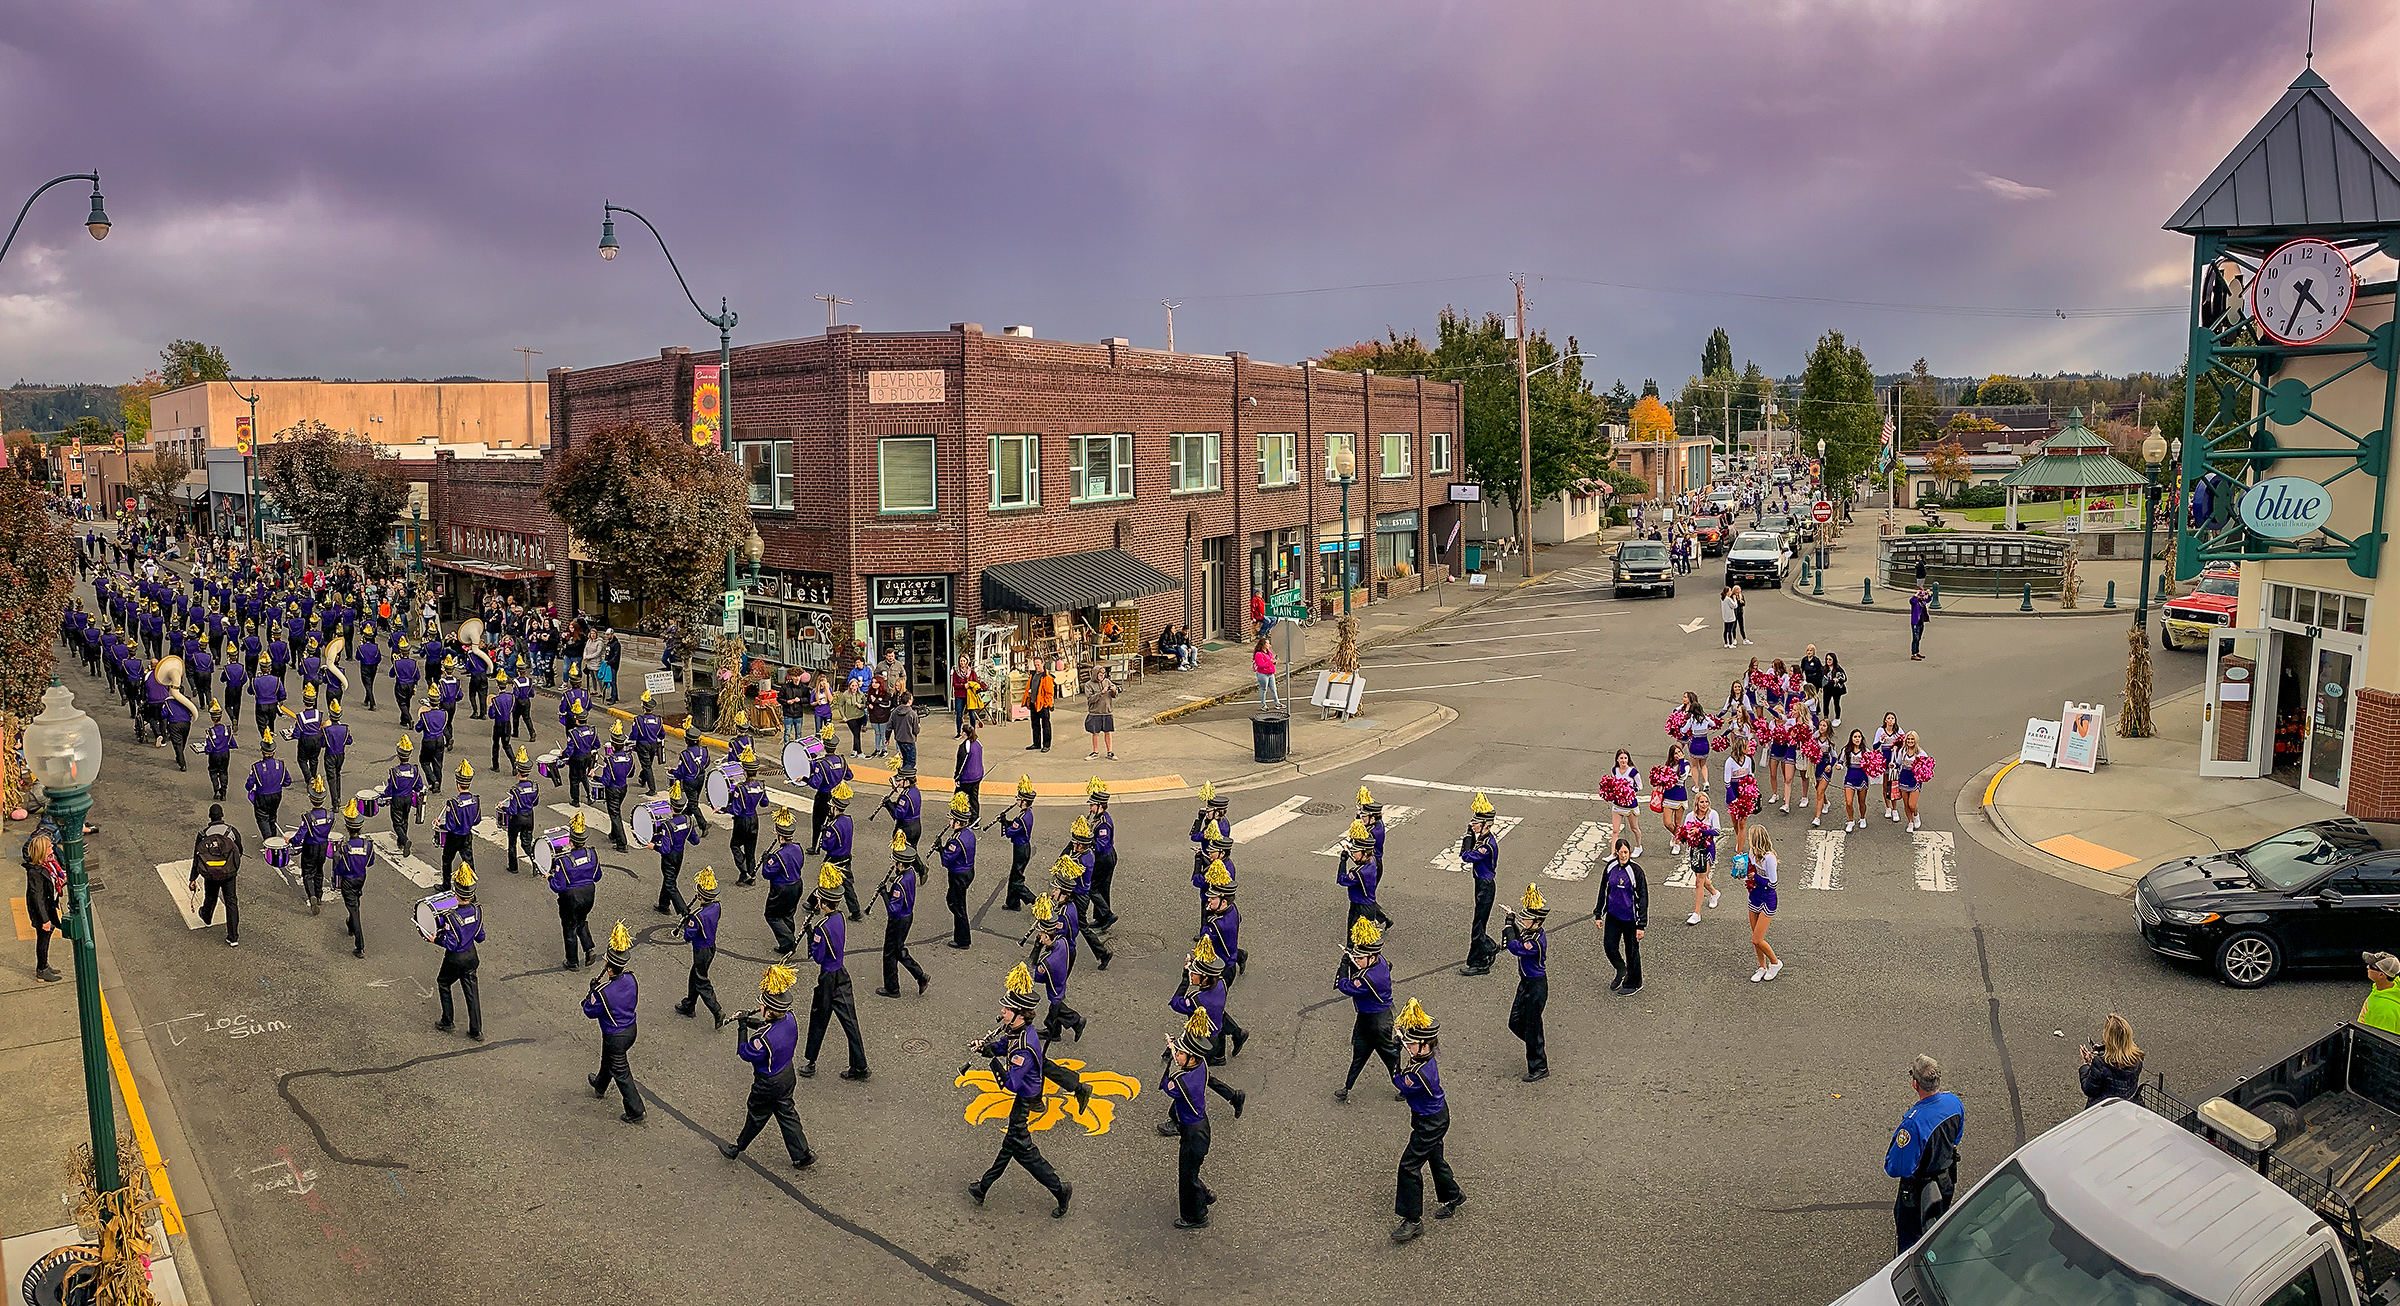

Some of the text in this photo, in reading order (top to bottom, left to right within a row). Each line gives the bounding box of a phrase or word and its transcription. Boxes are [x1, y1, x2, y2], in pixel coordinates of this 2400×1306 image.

[2283, 253, 2293, 265] 11
[2301, 247, 2313, 259] 12
[2323, 252, 2328, 264] 1
[2267, 267, 2279, 280] 10
[2334, 266, 2342, 278] 2
[2263, 286, 2270, 299] 9
[2337, 285, 2345, 297] 3
[2266, 305, 2274, 318] 8
[2330, 304, 2338, 317] 4
[2279, 319, 2286, 331] 7
[2297, 324, 2304, 336] 6
[2315, 319, 2323, 331] 5
[871, 371, 943, 387] LEVERENZ
[873, 387, 942, 401] 19 BLDG 22
[2255, 484, 2321, 521] blue
[1392, 518, 1413, 527] ESTATE
[2260, 520, 2288, 528] Goodwill
[2289, 520, 2317, 529] Boutique
[783, 581, 830, 605] Nest
[896, 588, 926, 596] Nest
[727, 594, 736, 608] P
[879, 595, 943, 604] 1002 Main Street
[1270, 592, 1293, 607] CHERRY
[1273, 606, 1300, 617] MAIN ST
[2304, 625, 2323, 639] 101
[653, 671, 673, 679] PARKING
[2328, 683, 2342, 694] blue
[2028, 731, 2055, 741] FARMERS
